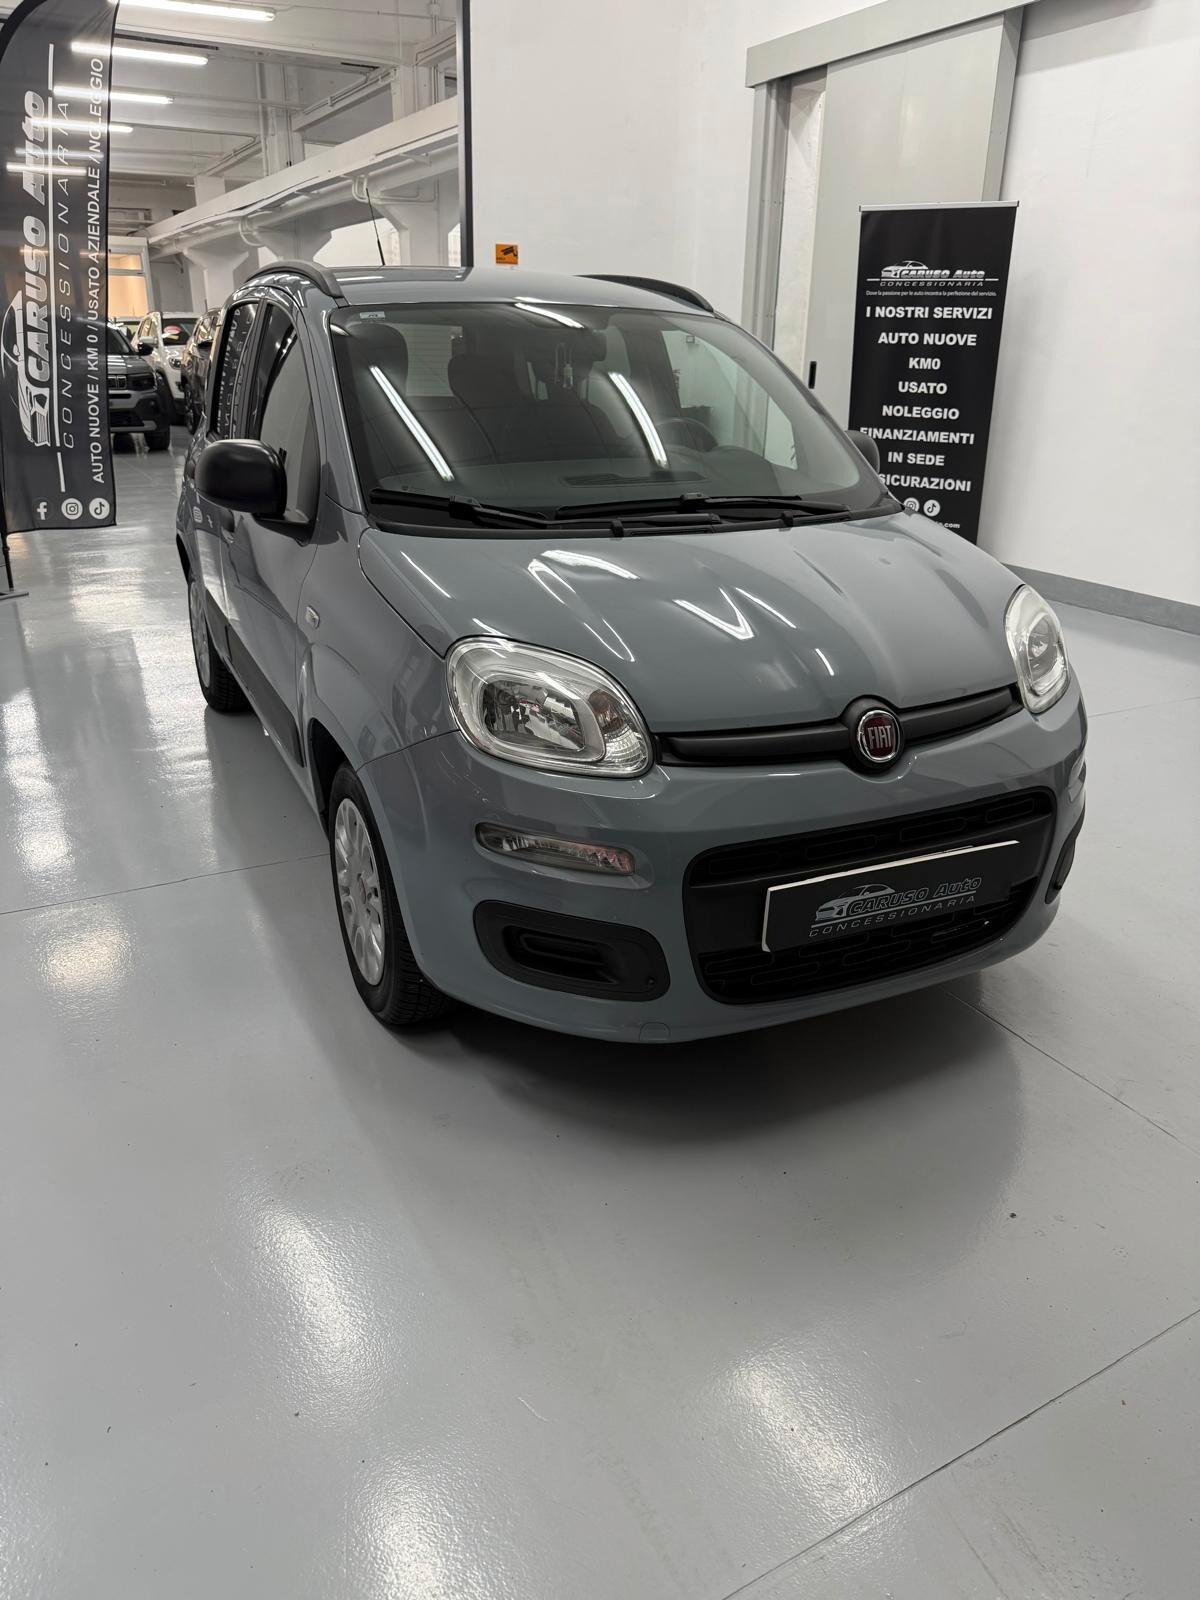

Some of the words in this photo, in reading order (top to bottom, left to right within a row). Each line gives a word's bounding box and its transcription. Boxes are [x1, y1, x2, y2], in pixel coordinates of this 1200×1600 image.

[22, 91, 45, 206] Auto
[88, 167, 101, 263] AZIENDALE
[58, 103, 74, 448] CONCESSIONARIA
[900, 269, 950, 278] CARUSO
[953, 269, 985, 278] Auto
[23, 216, 49, 382] CARUSO
[87, 267, 100, 321] USATO
[865, 306, 871, 318] I
[875, 306, 929, 318] NOSTRI
[933, 307, 993, 319] SERVIZI
[87, 334, 98, 343] 0
[878, 332, 919, 344] AUTO
[923, 333, 977, 346] NUOVE
[87, 347, 98, 371] KM
[908, 357, 941, 370] KM0
[898, 381, 948, 394] USATO
[87, 384, 100, 438] NUOVE
[882, 405, 960, 420] NOLEGGIO
[860, 427, 975, 445] FINANZIAMENTI
[89, 441, 104, 484] AUTO
[887, 451, 903, 463] IN
[907, 453, 945, 466] SEDE
[878, 473, 972, 492] SICURAZIONI
[867, 725, 892, 749] FIAT
[849, 887, 929, 915] CARUSO
[934, 877, 982, 898] Auto
[808, 895, 976, 937] CONCESSIONARIA
